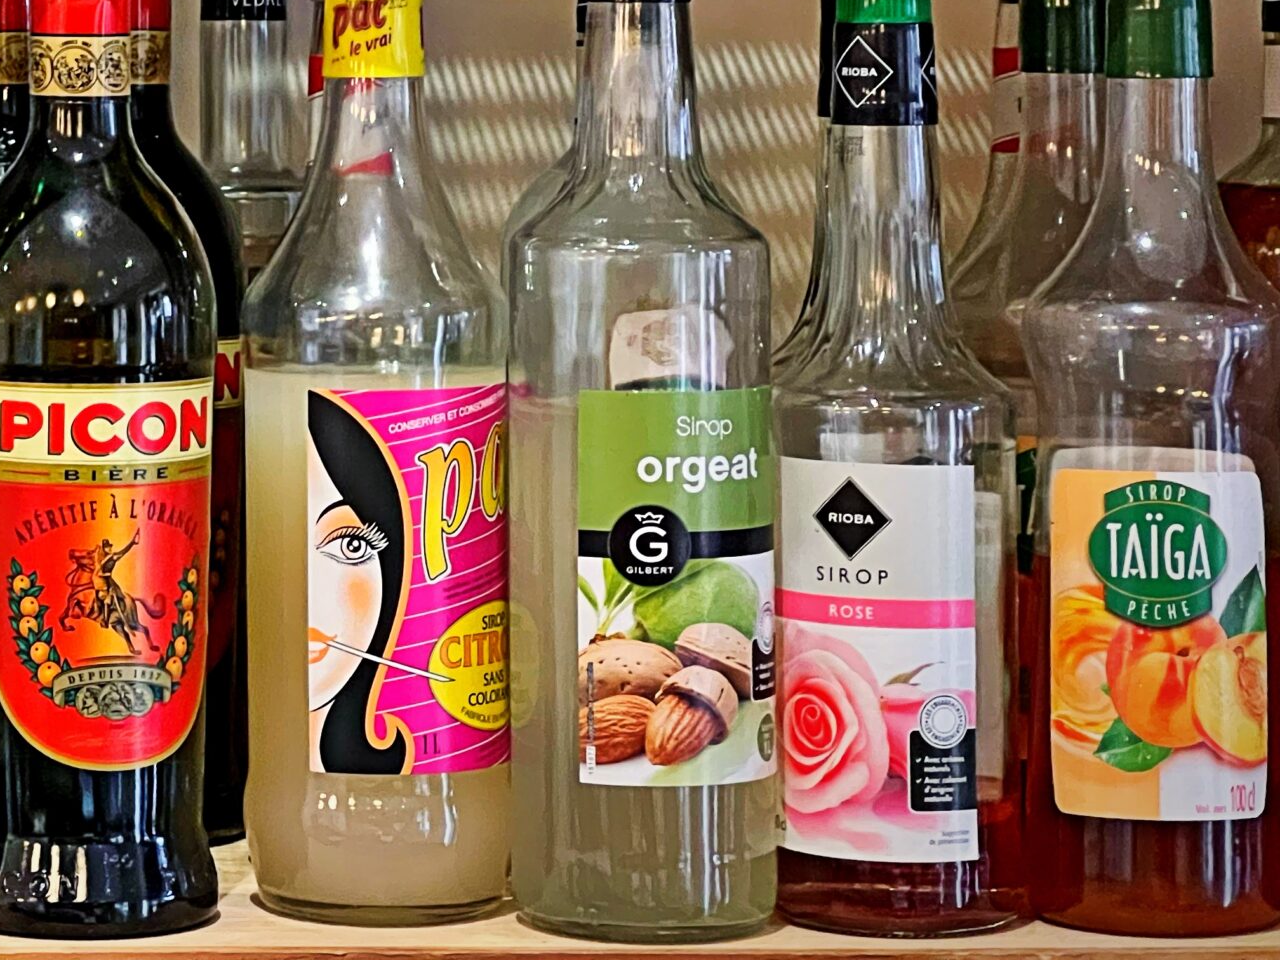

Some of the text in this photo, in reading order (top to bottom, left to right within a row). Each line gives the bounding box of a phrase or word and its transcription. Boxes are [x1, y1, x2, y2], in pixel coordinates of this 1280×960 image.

[350, 27, 391, 56] le vrai
[841, 67, 878, 78] RIOBA
[0, 395, 208, 457] PICON
[388, 409, 458, 434] CONSERVER ET
[676, 415, 733, 441] Sirop
[63, 464, 169, 482] BIÈRE
[636, 447, 758, 494] orgeat
[415, 420, 507, 586] pa
[1126, 484, 1186, 503] SIROP
[14, 499, 98, 546] APÉRITIF
[109, 493, 120, 520] À
[828, 512, 874, 525] RIOBA
[629, 526, 669, 563] G
[1106, 512, 1211, 580] TAÏGA
[625, 566, 675, 576] GILBERT
[816, 565, 889, 585] SIROP
[829, 604, 874, 620] ROSE
[67, 668, 123, 685] DEPUIS
[483, 669, 504, 687] SANS
